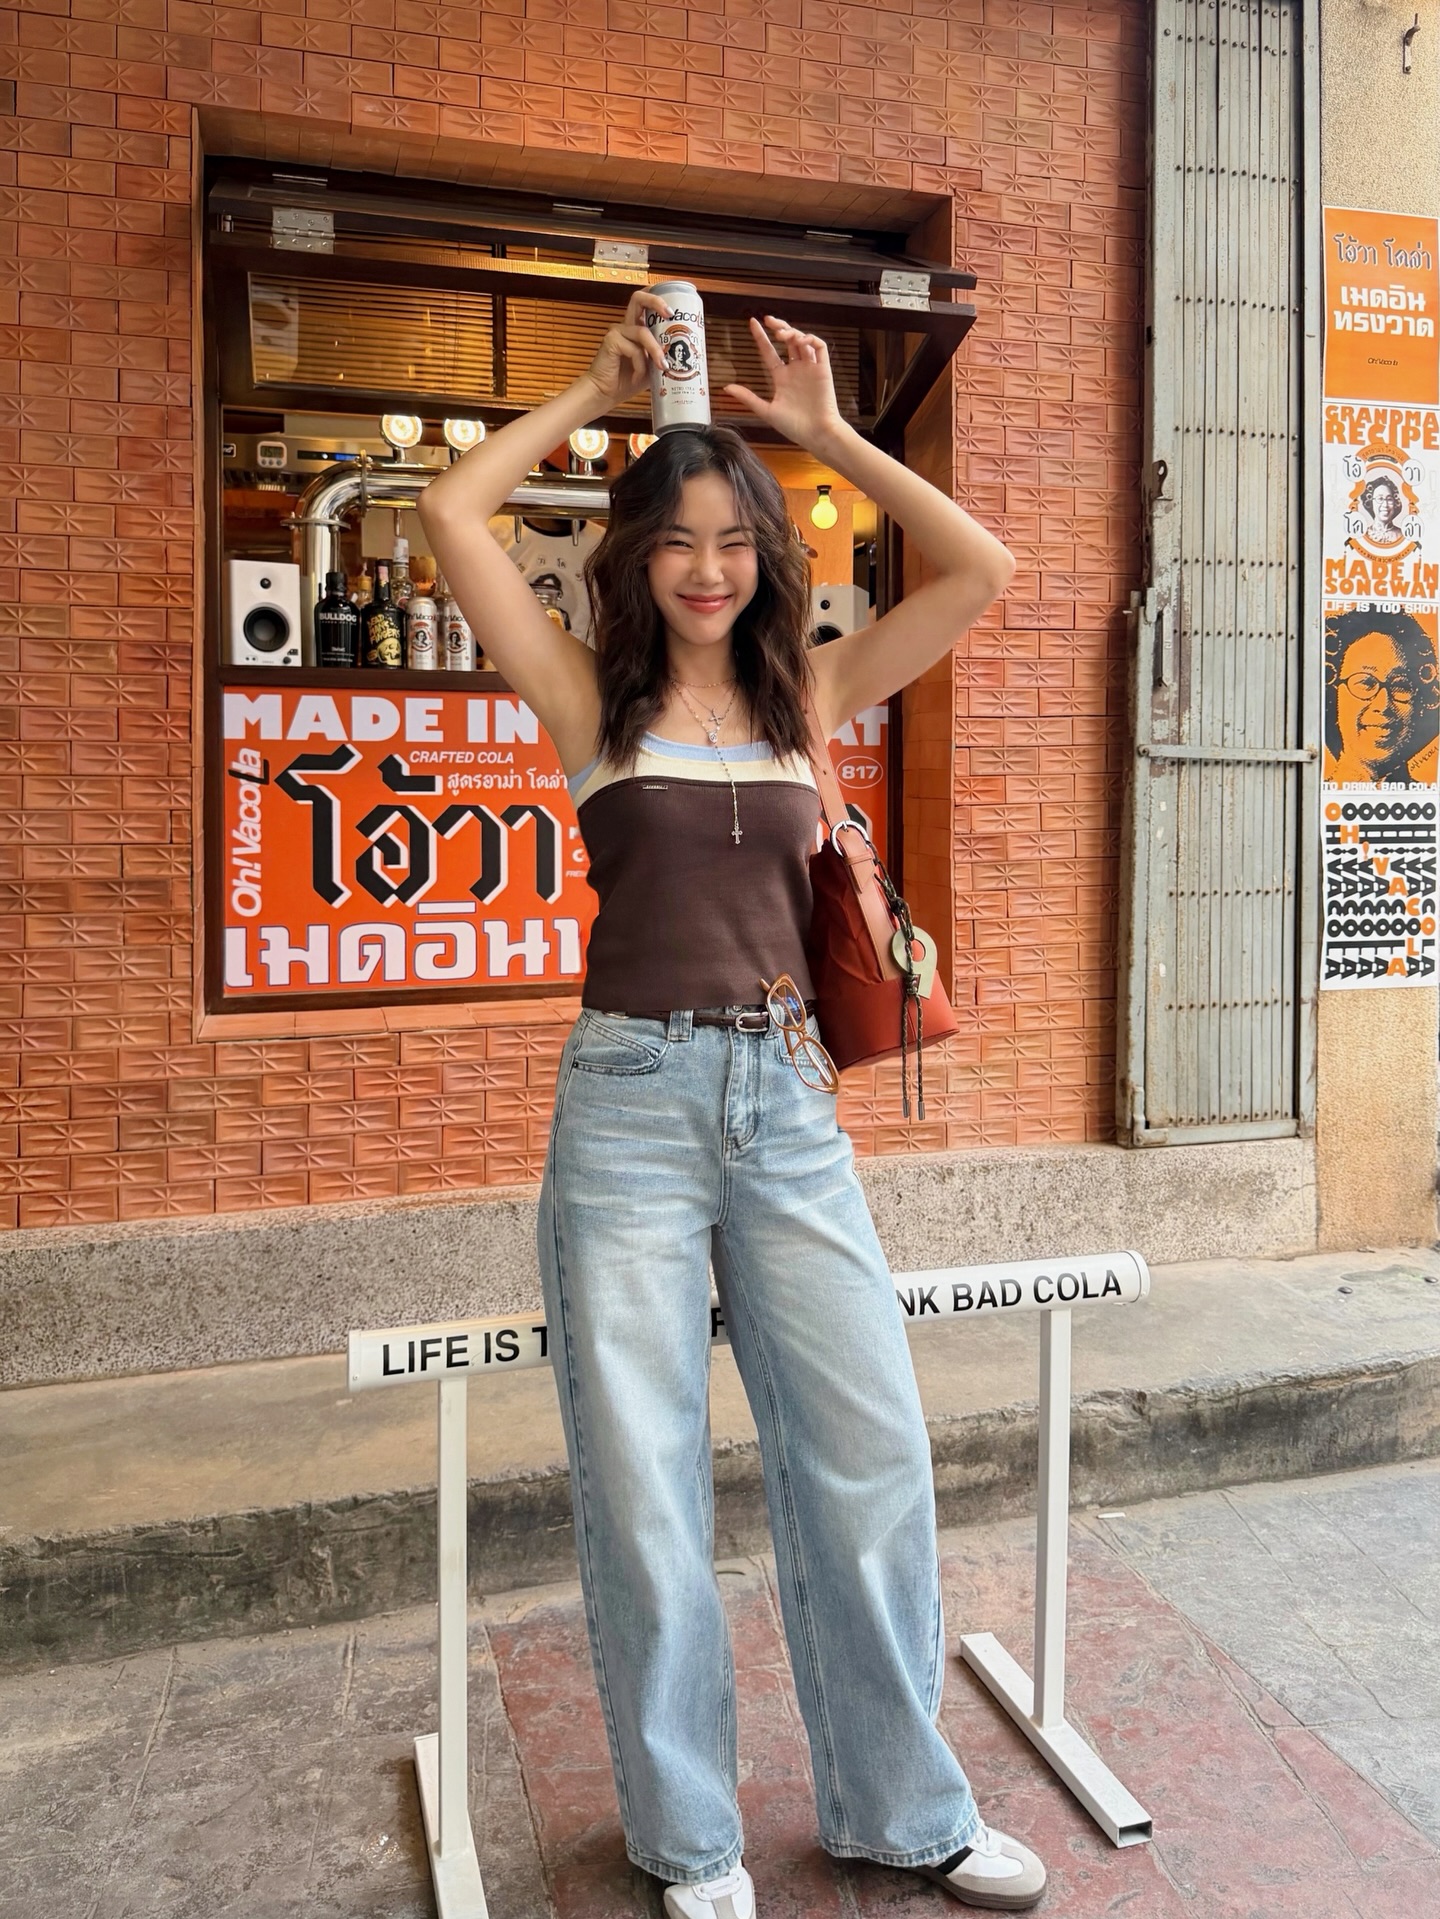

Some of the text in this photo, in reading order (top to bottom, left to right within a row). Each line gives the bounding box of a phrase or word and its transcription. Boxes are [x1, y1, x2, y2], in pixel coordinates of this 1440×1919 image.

[1341, 284, 1425, 312] เมดอิน
[1333, 309, 1434, 338] ทรงวาด
[1325, 405, 1440, 428] GRANDMA
[1325, 420, 1440, 450] RECIPE
[1325, 558, 1439, 588] MADE IN
[1325, 577, 1438, 598] SONGWAT
[319, 612, 357, 622] BULLDOG
[1325, 601, 1352, 611] LIFE
[1356, 602, 1370, 612] IS
[1374, 602, 1400, 614] TOO
[224, 693, 444, 742] MADE
[467, 699, 539, 744] IN
[409, 750, 514, 764] CRAFTED COLA
[447, 768, 523, 797] สูตรอาม่า
[841, 765, 879, 780] 817
[1323, 782, 1437, 791] TO DRINK BAD COLA
[231, 857, 262, 918] Oh!
[382, 1335, 470, 1376] LIFE
[484, 1329, 520, 1364] IS
[951, 1278, 1022, 1312] BAD
[1033, 1269, 1122, 1304] COLA
